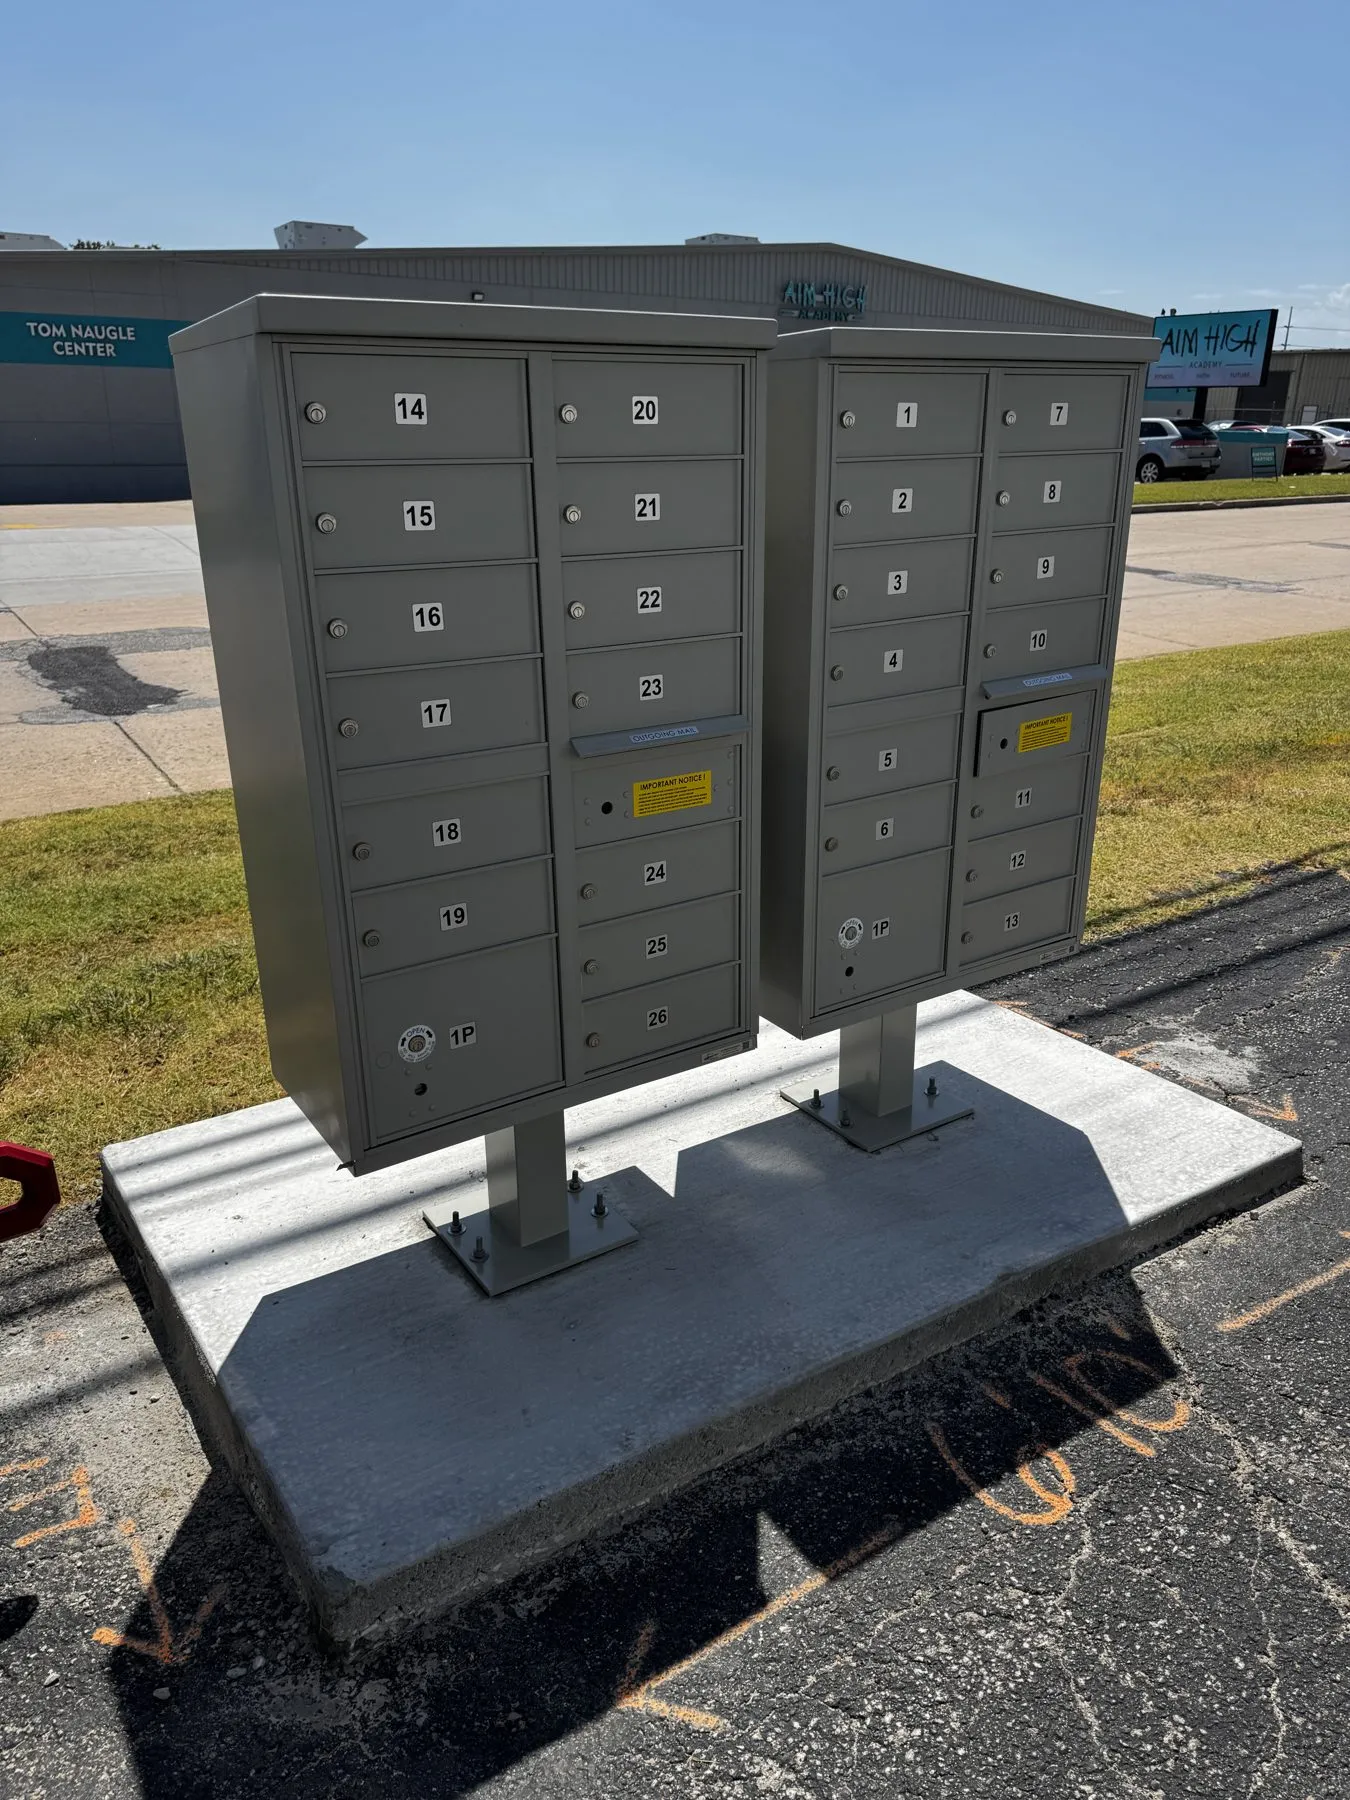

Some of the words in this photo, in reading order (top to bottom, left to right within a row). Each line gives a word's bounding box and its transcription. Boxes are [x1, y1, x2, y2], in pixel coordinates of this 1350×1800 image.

[782, 280, 816, 308] AIM
[823, 284, 868, 313] HIGH
[26, 322, 66, 338] TOM
[70, 324, 136, 341] NAUGLE
[1160, 327, 1198, 357] AIM
[1204, 319, 1260, 358] HIGH
[53, 341, 117, 357] CENTER
[1188, 361, 1223, 369] ACADEMY
[398, 398, 424, 419] 14
[634, 400, 655, 420] 20
[904, 406, 911, 423] 1
[1055, 406, 1064, 421] 7
[1048, 484, 1057, 500] 8
[637, 498, 656, 517] 21
[897, 492, 907, 509] 2
[407, 506, 432, 526] 15
[1041, 559, 1050, 574] 9
[893, 575, 902, 590] 3
[640, 590, 660, 609] 22
[416, 607, 440, 627] 16
[1032, 633, 1045, 648] 10
[888, 653, 898, 667] 4
[642, 679, 661, 697] 23
[424, 704, 447, 723] 17
[1025, 720, 1049, 729] IMPORTANT
[633, 731, 676, 741] OUTGOING
[678, 727, 696, 735] MAIL
[883, 753, 892, 767] 5
[640, 779, 677, 790] IMPORTANT
[679, 775, 702, 784] NOTICE
[1018, 791, 1030, 805] 11
[436, 823, 458, 842] 18
[880, 822, 889, 836] 6
[1012, 854, 1024, 867] 12
[646, 864, 665, 882] 24
[443, 908, 464, 926] 19
[1006, 915, 1018, 928] 13
[873, 921, 888, 936] 1P
[648, 937, 666, 954] 25
[649, 1010, 666, 1026] 26
[407, 1028, 425, 1037] OPEN
[451, 1026, 474, 1045] 1P
